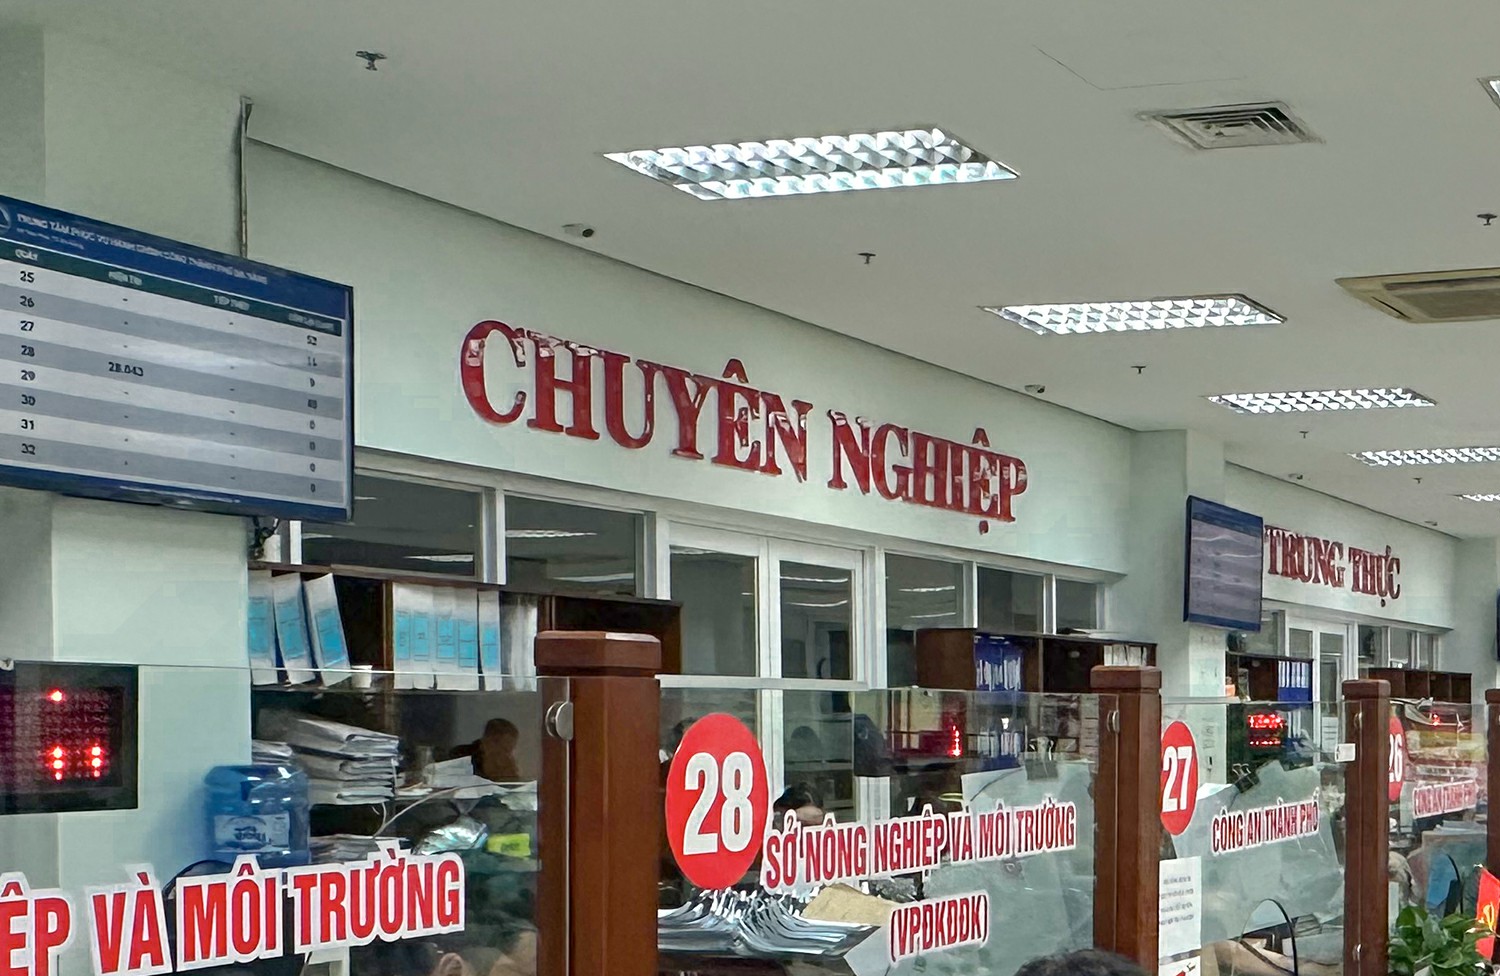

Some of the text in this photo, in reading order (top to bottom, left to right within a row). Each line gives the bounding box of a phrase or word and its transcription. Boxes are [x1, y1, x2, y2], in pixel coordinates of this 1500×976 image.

[20, 271, 35, 283] 25
[20, 295, 35, 308] 26
[20, 320, 35, 332] 27
[21, 345, 35, 357] 28
[21, 394, 36, 406] 30
[21, 418, 35, 430] 31
[460, 319, 1028, 535] CHUYÊN NGHIỆP
[21, 443, 36, 455] 32
[1263, 525, 1401, 608] TRUNG THỰC
[683, 751, 754, 856] 28
[1162, 746, 1193, 813] 27
[766, 797, 1075, 889] SỞ NÔNG NGHIỆP VÀ MÔI TRƯỜNG
[1212, 791, 1319, 853] CÔNG AN THÀNH PHỐ
[93, 871, 164, 975] VÀ
[183, 862, 277, 963] MÔI
[293, 847, 460, 946] TRƯỜNG
[890, 894, 988, 962] (VPĐKĐĐK)
